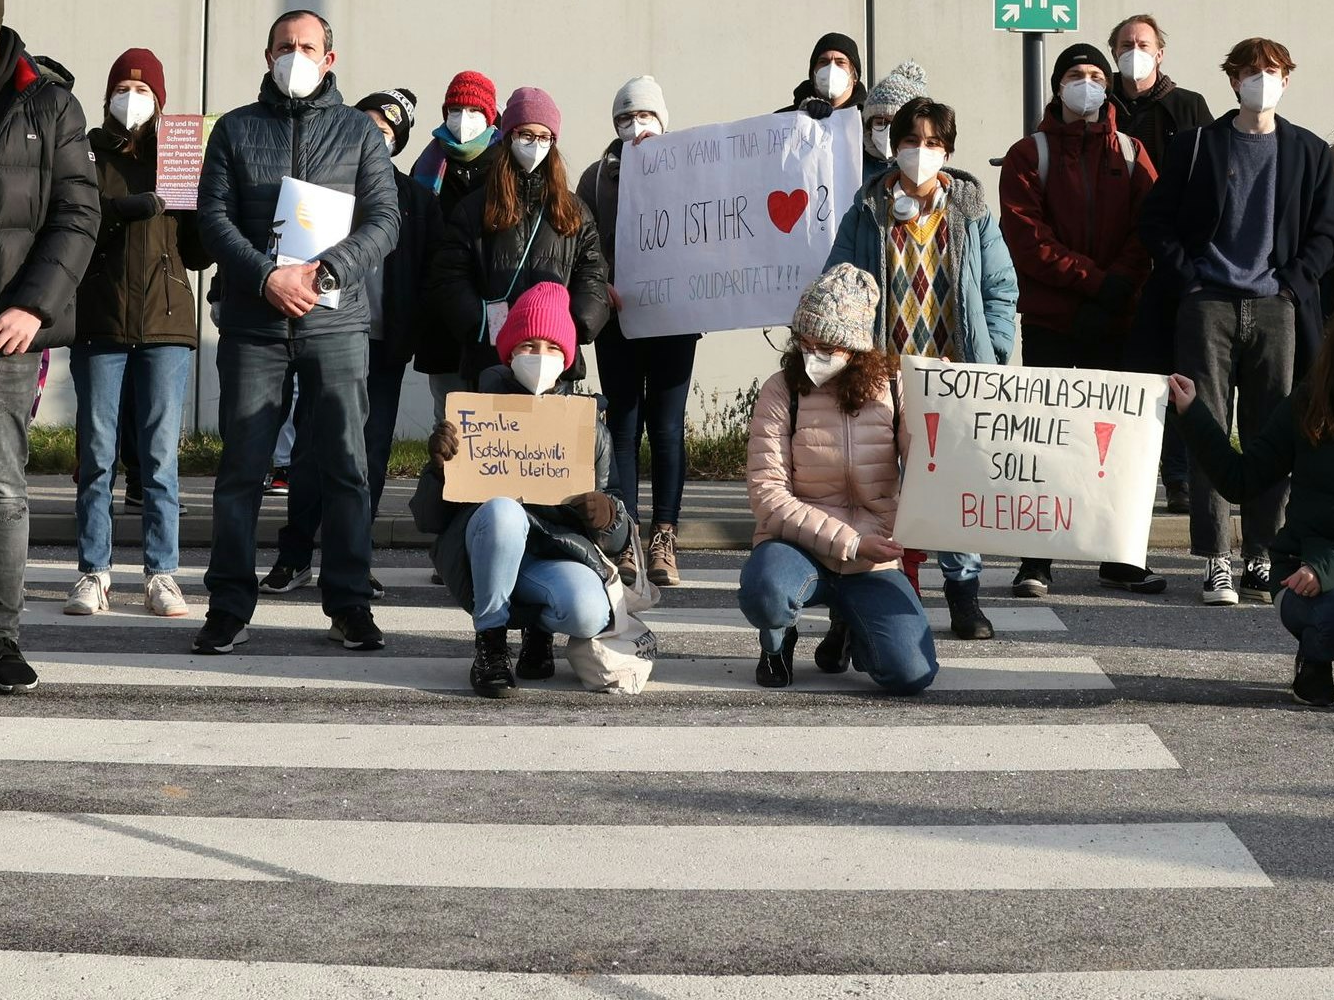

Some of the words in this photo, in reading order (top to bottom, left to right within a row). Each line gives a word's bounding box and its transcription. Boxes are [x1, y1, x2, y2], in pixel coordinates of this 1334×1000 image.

[642, 147, 677, 176] WAS
[686, 140, 721, 166] KANN
[727, 134, 759, 160] TINA
[638, 209, 670, 252] WO
[684, 200, 712, 246] IST
[717, 195, 755, 241] IHR
[636, 277, 675, 307] ZEIGT
[914, 367, 1146, 417] TSOTSKHALASHVILI
[457, 410, 520, 434] Familie
[973, 411, 1071, 446] FAMILIE
[462, 434, 565, 461] Tsotskhalashvili
[520, 462, 570, 479] bleiben
[989, 452, 1046, 484] SOLL
[961, 492, 1073, 532] BLEIBEN
